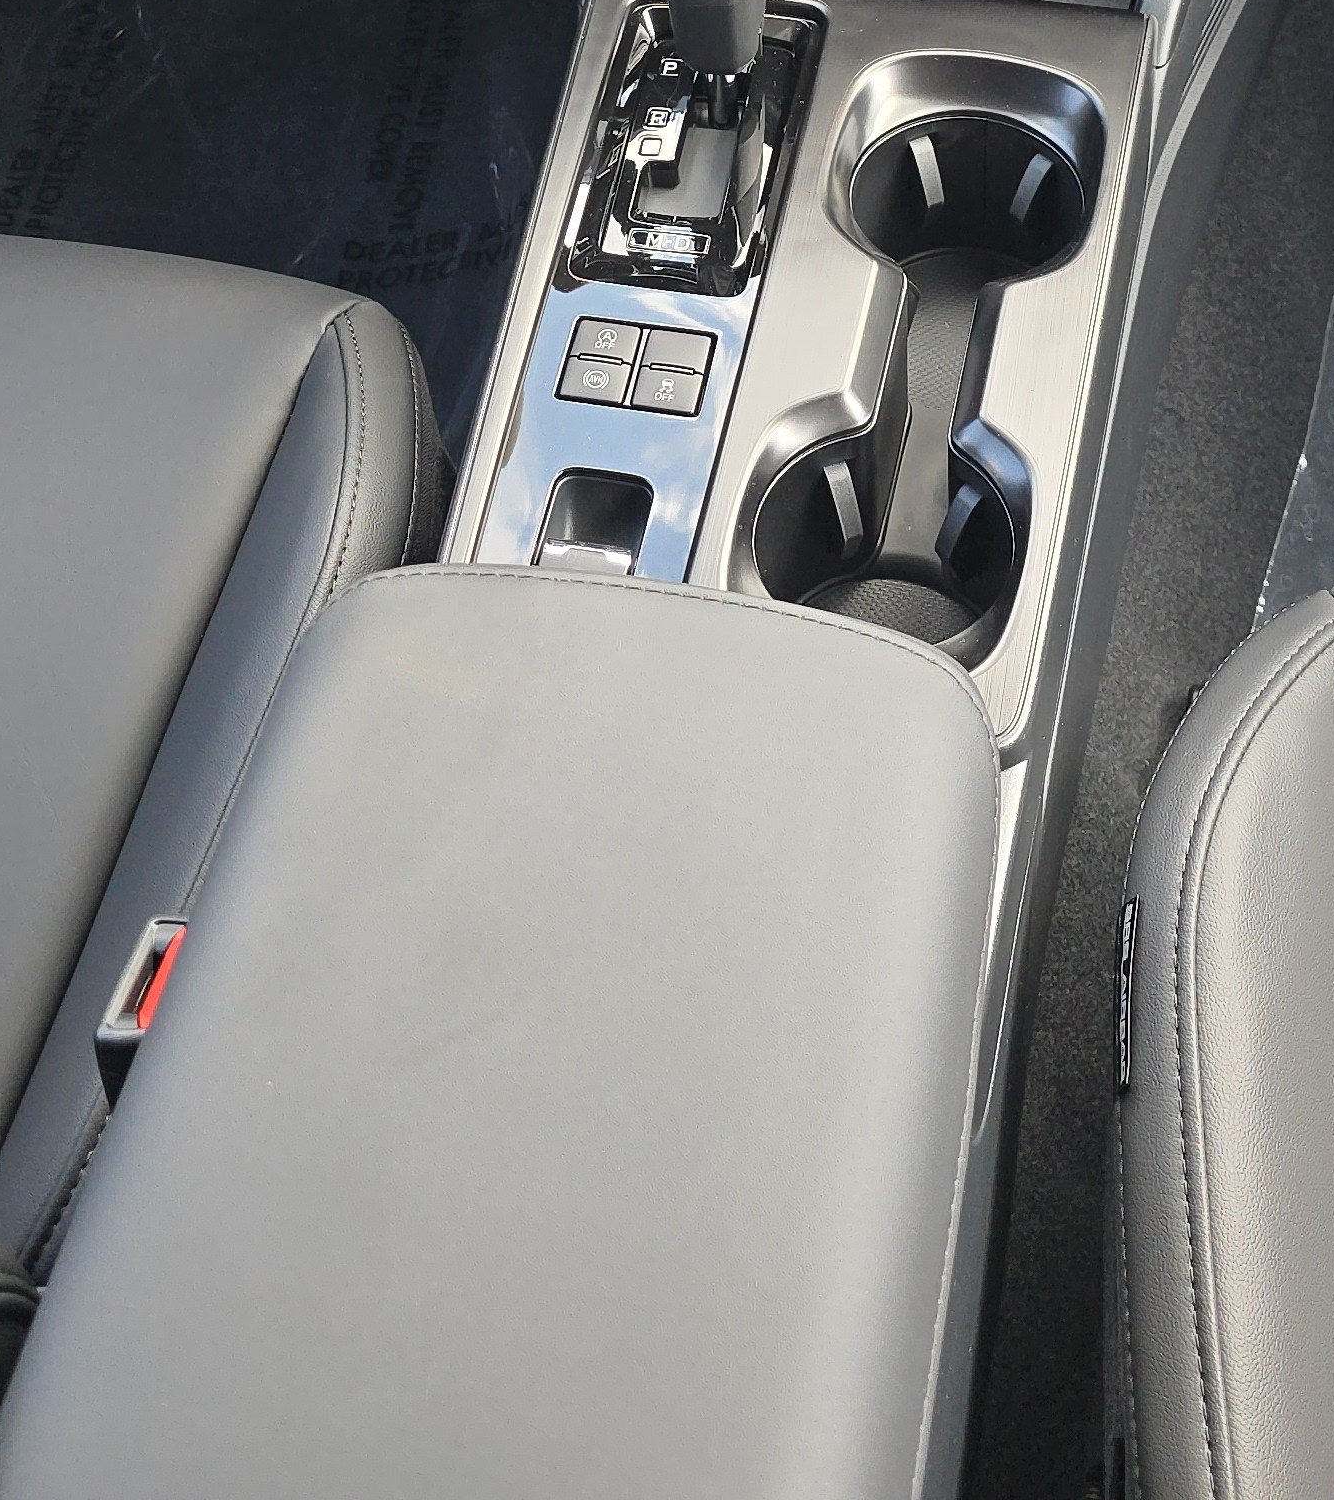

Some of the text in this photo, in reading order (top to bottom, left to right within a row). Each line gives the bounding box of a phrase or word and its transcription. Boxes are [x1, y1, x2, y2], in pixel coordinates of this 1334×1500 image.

[662, 61, 678, 75] P
[343, 231, 460, 263] DEALER
[594, 341, 617, 350] OFF
[654, 391, 676, 401] OFF
